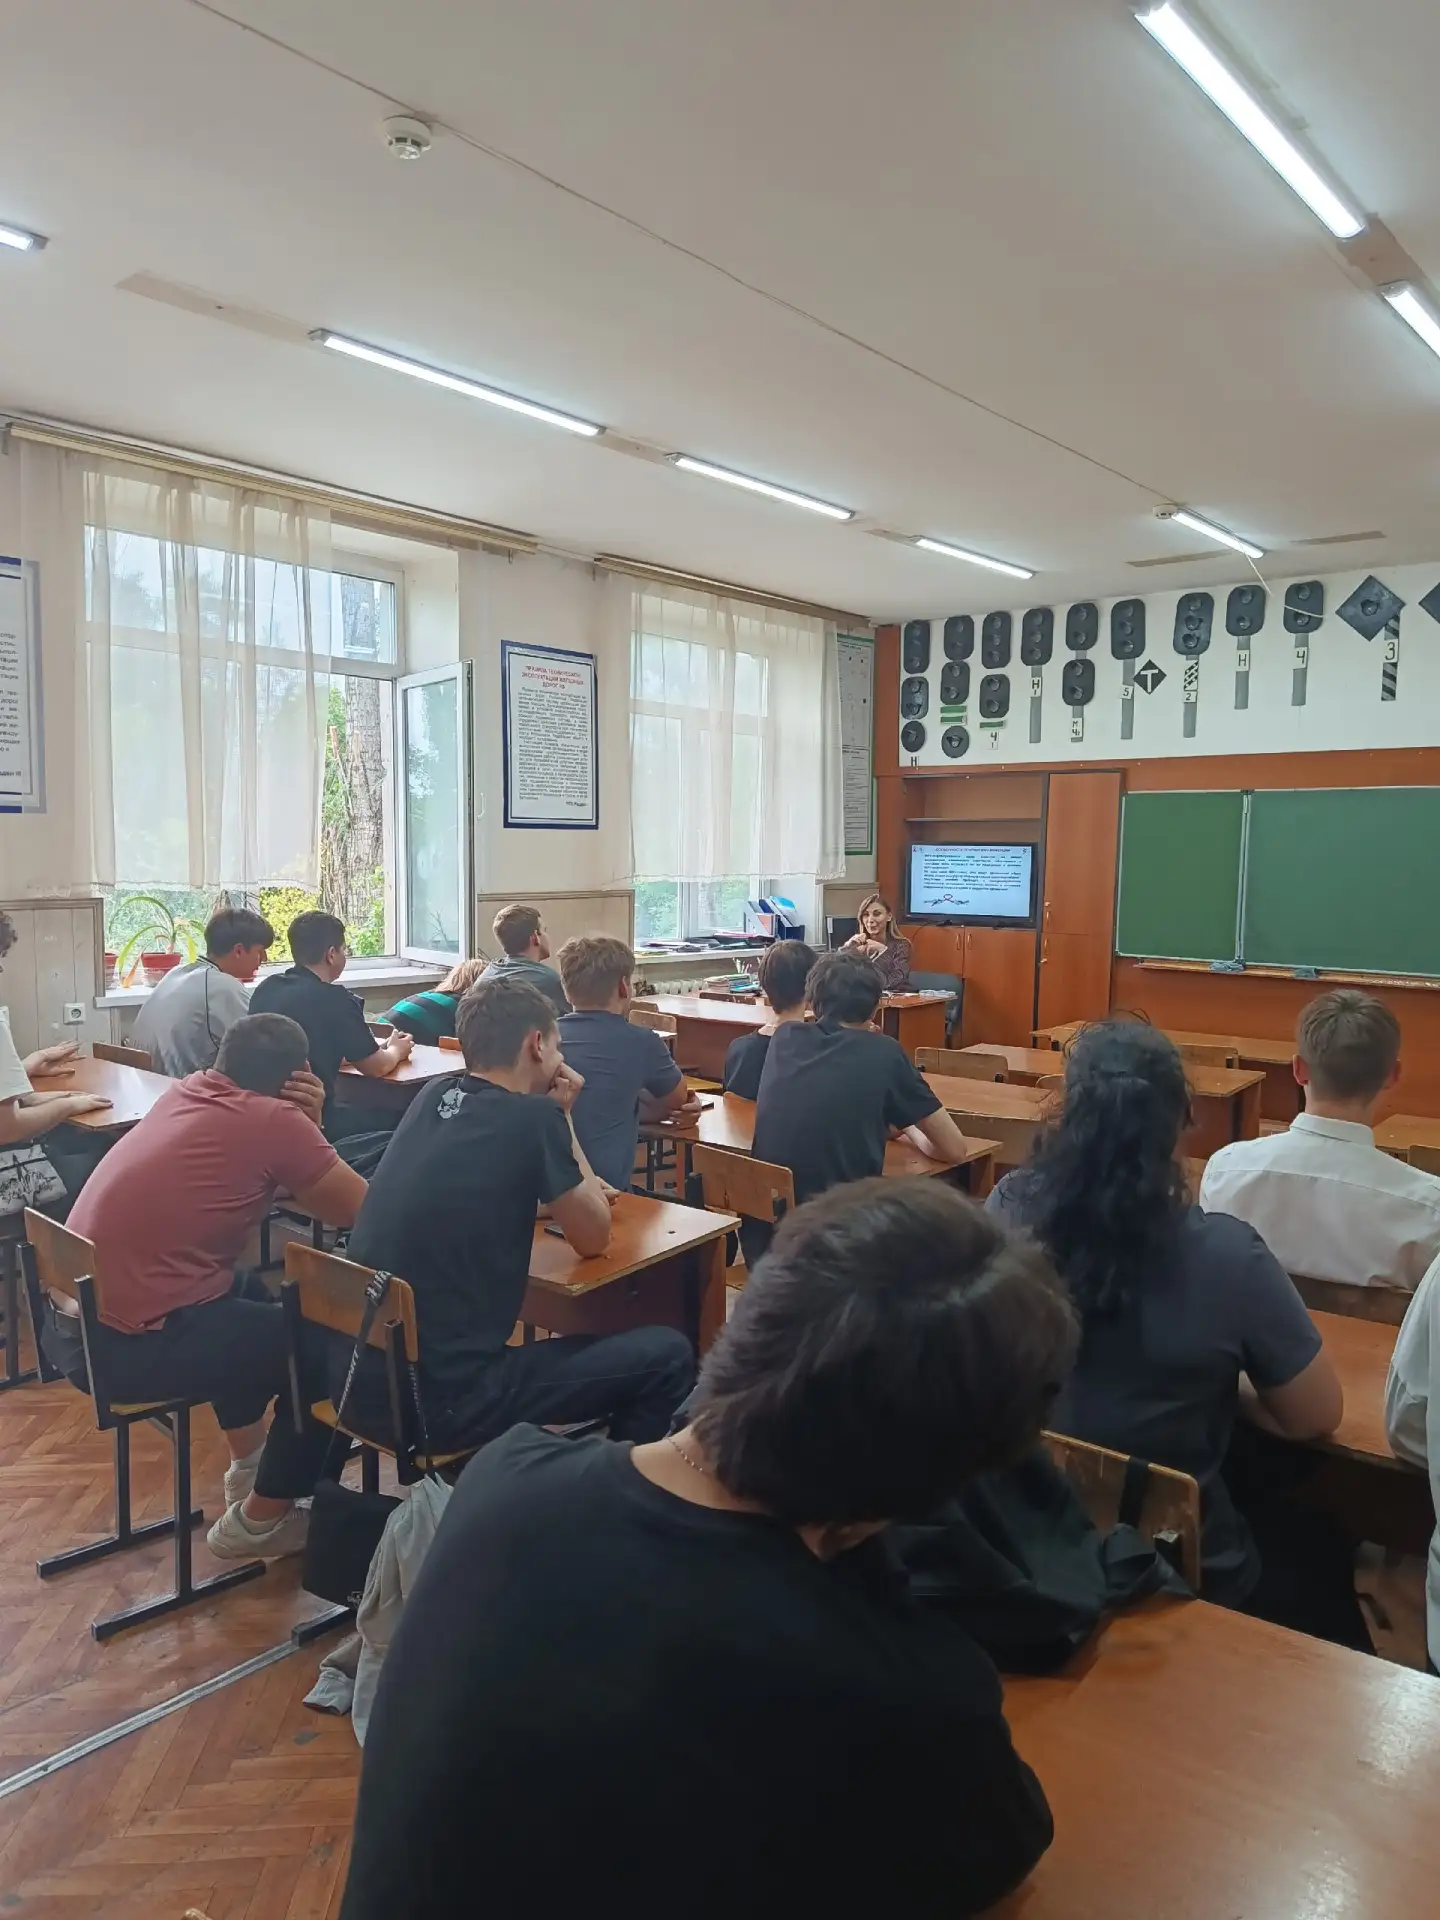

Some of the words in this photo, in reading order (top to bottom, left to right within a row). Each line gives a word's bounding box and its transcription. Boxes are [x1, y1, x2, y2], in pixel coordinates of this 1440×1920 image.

[1384, 641, 1396, 660] 3
[1123, 687, 1130, 697] 5
[1185, 692, 1192, 701] 2
